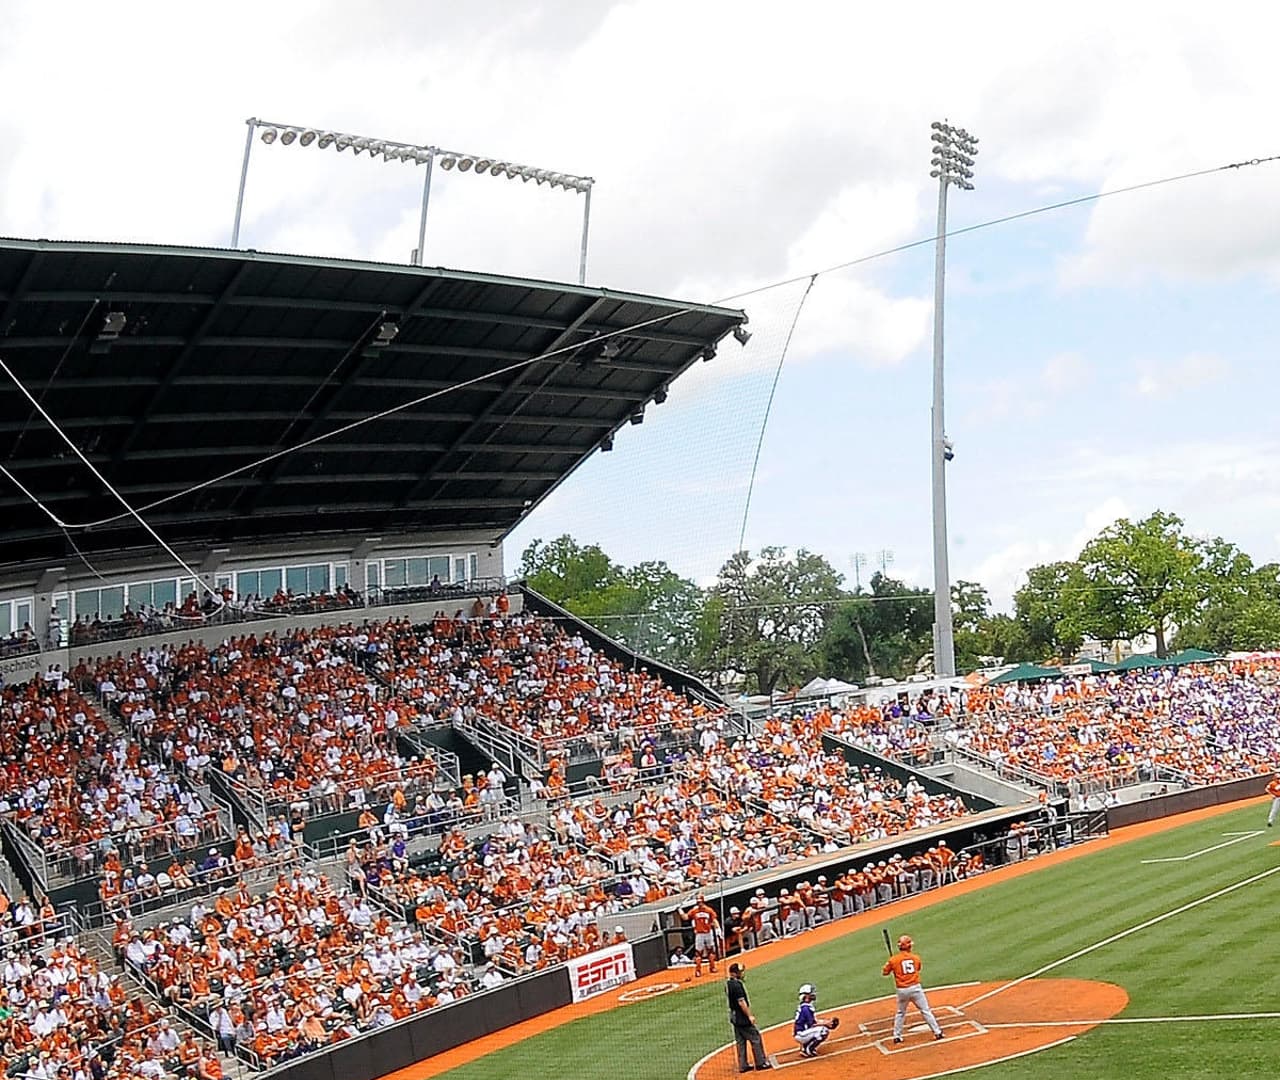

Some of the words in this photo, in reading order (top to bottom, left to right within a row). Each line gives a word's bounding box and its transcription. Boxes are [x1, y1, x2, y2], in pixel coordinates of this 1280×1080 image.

[0, 656, 40, 673] schnick
[577, 953, 627, 987] ESPN
[901, 959, 915, 974] 15
